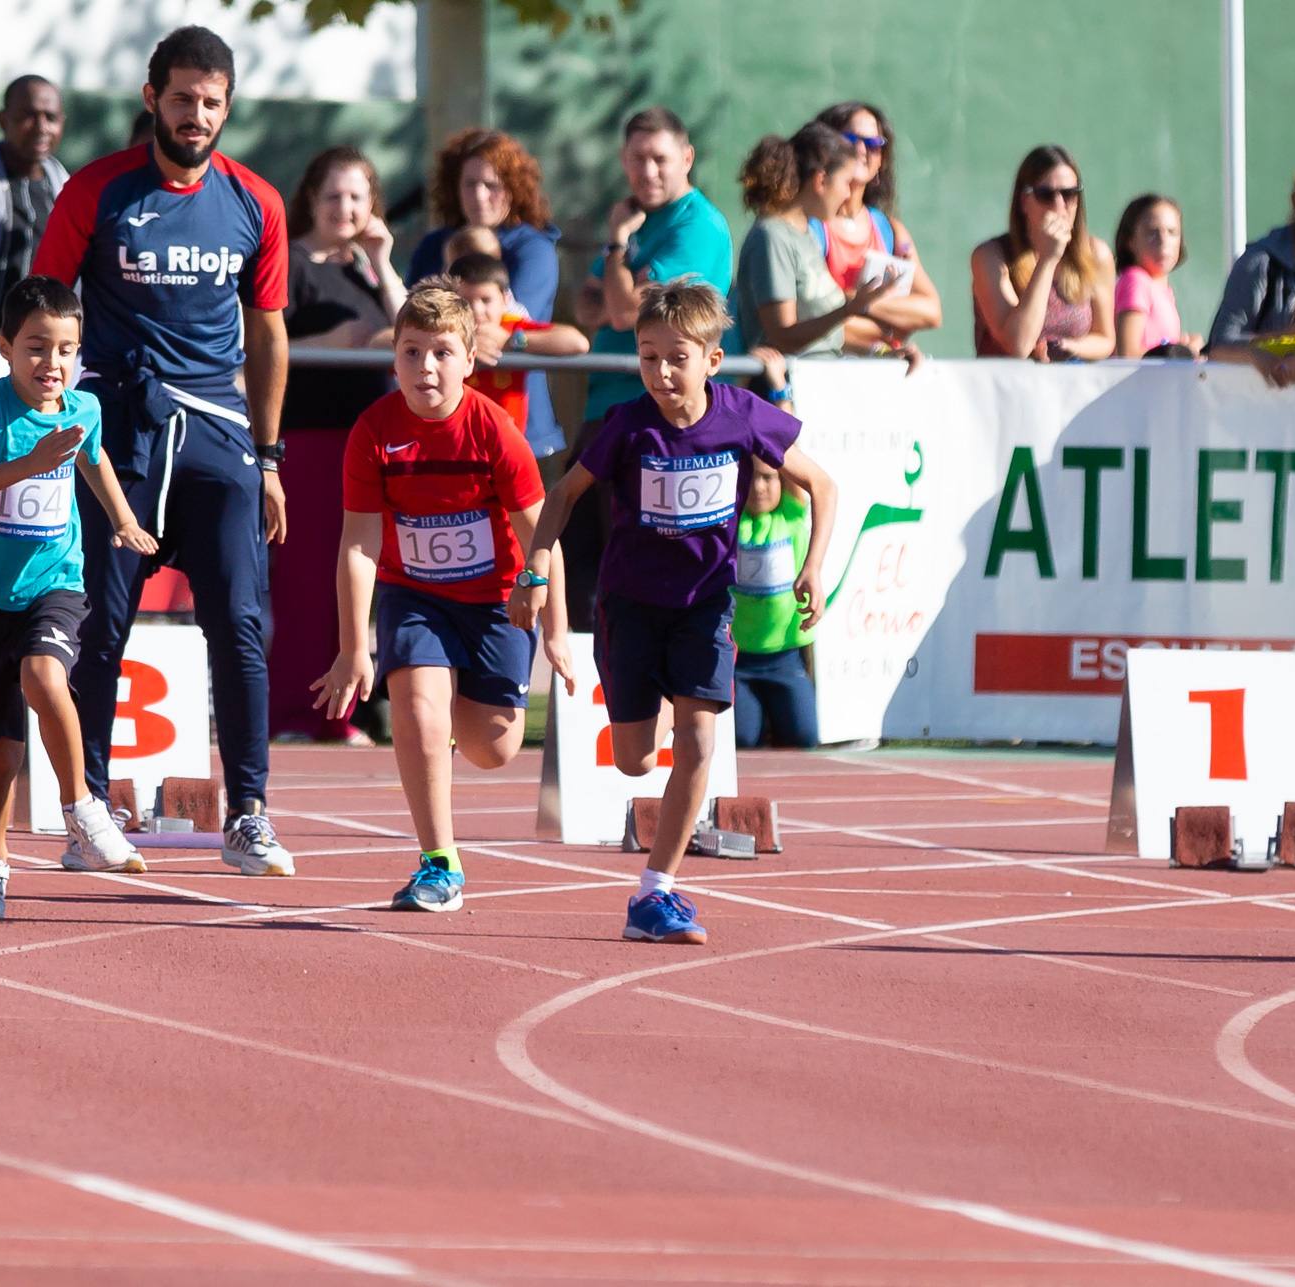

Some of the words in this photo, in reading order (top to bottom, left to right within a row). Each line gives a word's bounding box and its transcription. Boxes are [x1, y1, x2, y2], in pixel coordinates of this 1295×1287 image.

[118, 246, 157, 271] La
[167, 246, 244, 287] Rioja
[122, 272, 199, 286] atletismo
[672, 451, 735, 471] HEMAFIX
[651, 472, 723, 510] 162
[420, 510, 484, 528] HEMAFIX
[406, 529, 478, 565] 163
[1188, 688, 1248, 780] 1
